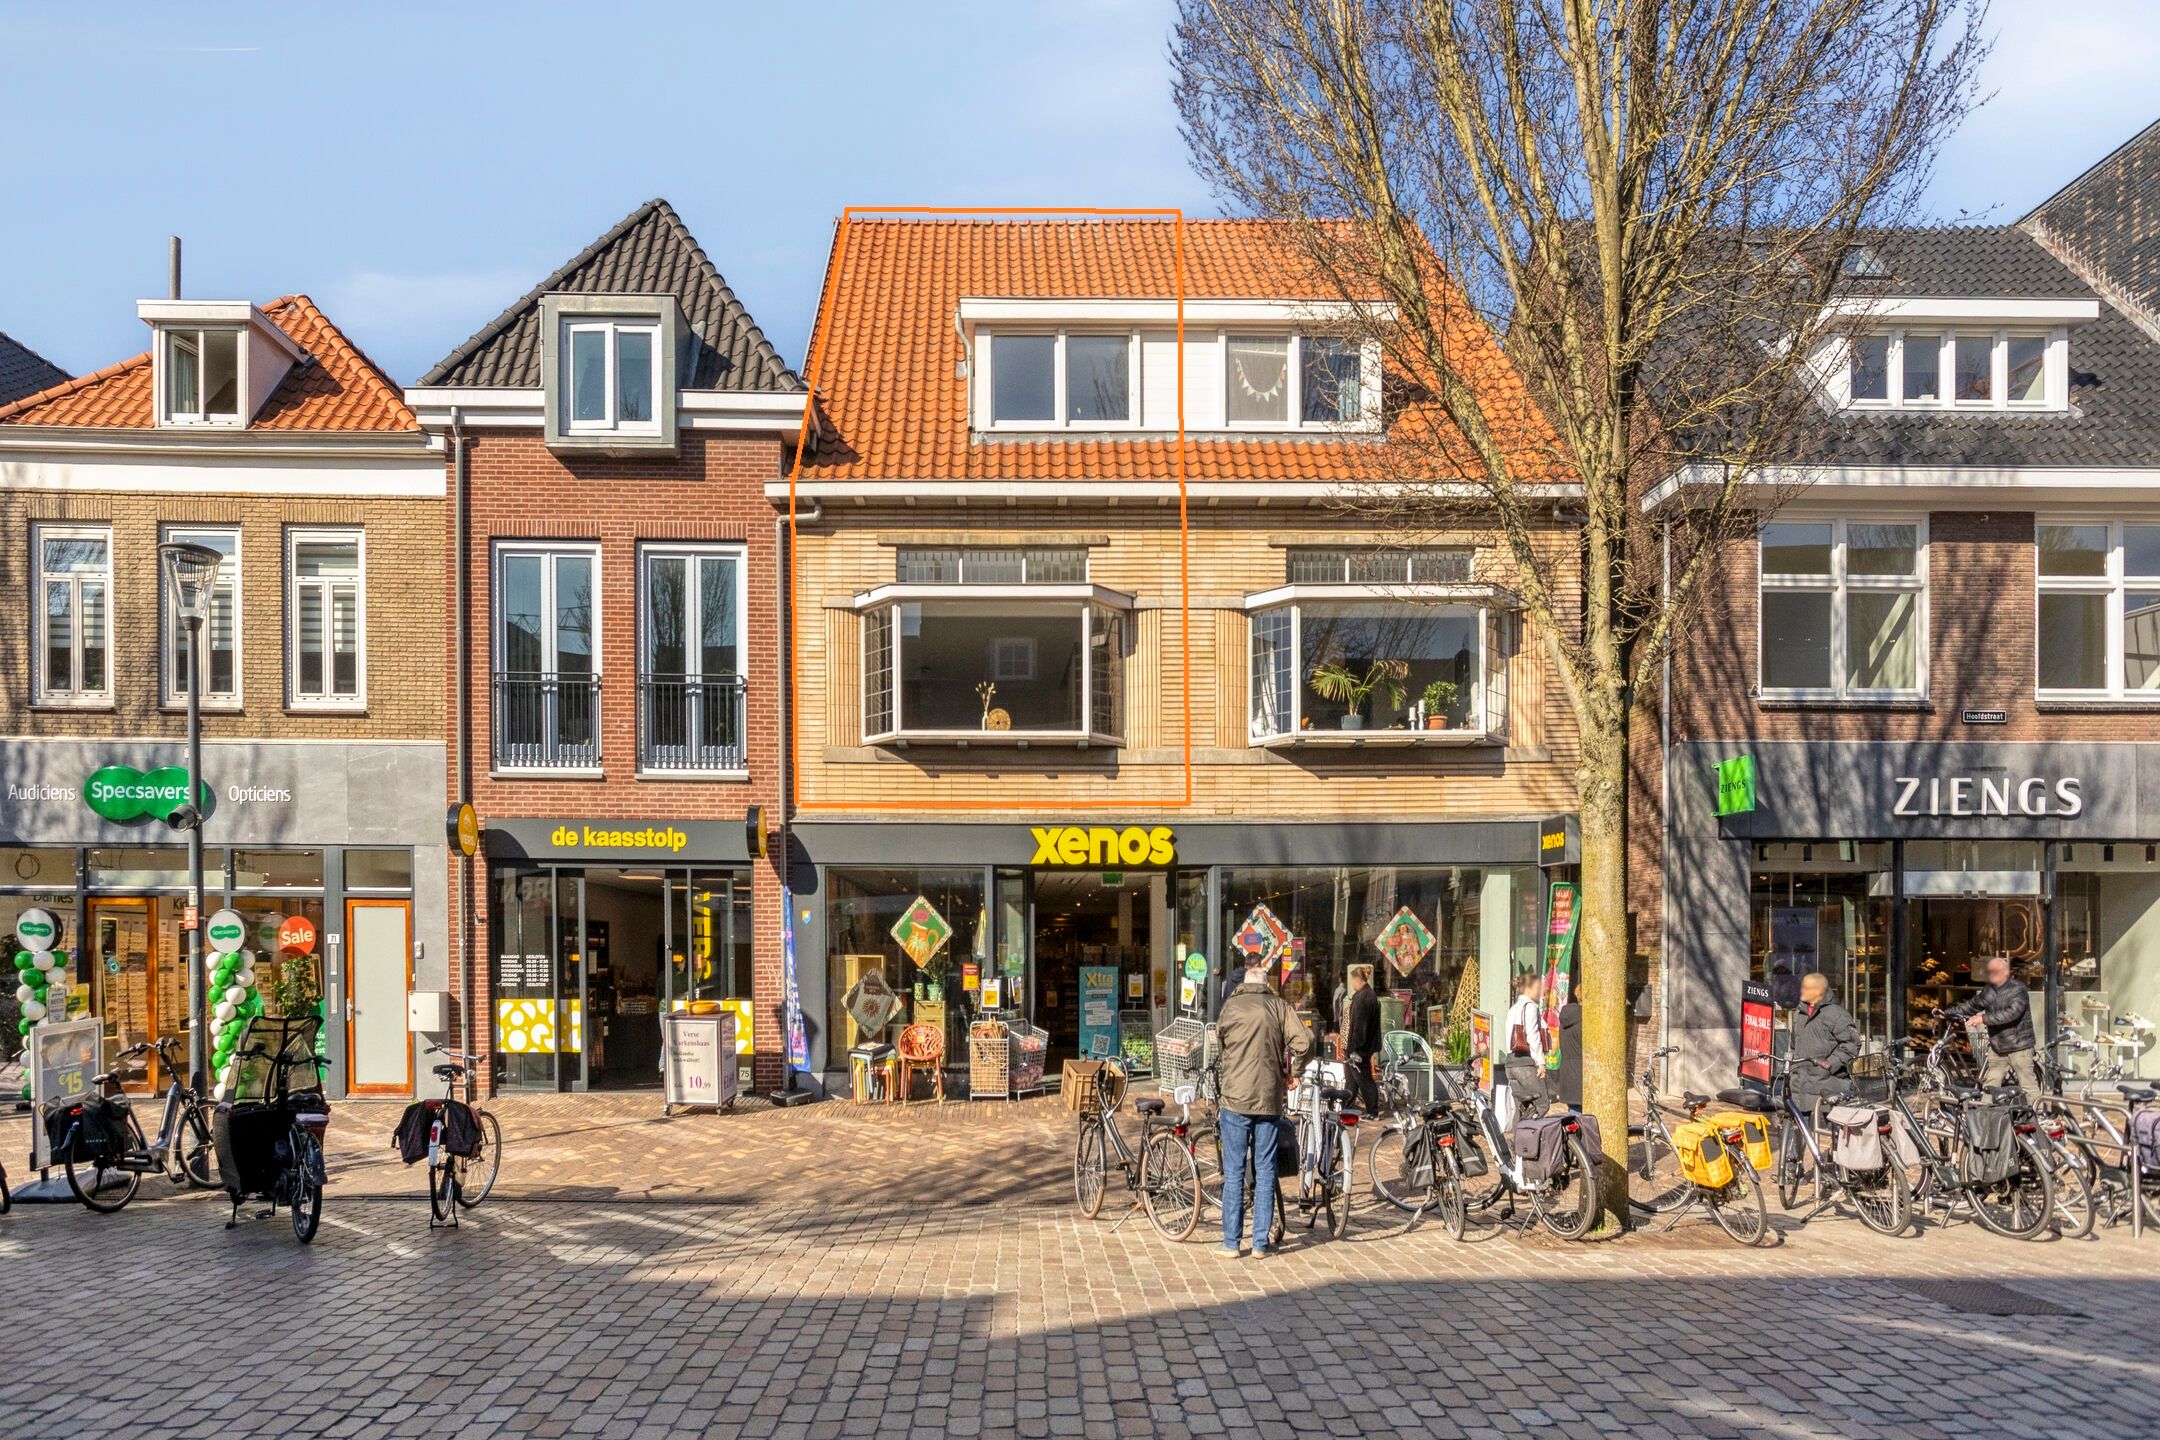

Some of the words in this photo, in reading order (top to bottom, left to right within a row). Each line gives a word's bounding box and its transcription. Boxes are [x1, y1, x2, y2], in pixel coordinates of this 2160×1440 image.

[1966, 712, 2003, 721] Hoofdstraat
[8, 784, 76, 800] Audiciens
[91, 781, 190, 801] Specsavers
[1721, 780, 1746, 793] ZIENGS
[228, 785, 292, 805] Opticiens
[1893, 777, 2082, 816] ZIENGS
[551, 825, 579, 847] de
[583, 825, 687, 853] kaasstolp
[1030, 826, 1175, 865] xenos
[1542, 831, 1565, 850] xenos
[173, 897, 189, 910] Kid
[21, 924, 50, 934] Specsavers
[212, 928, 240, 937] Specsavers
[281, 928, 313, 946] Sale
[330, 935, 337, 943] 71
[1747, 986, 1769, 998] ZIENGS
[1745, 1014, 1758, 1027] FINAL
[1758, 1017, 1770, 1029] SALE
[1750, 1028, 1769, 1050] 70%
[740, 1069, 750, 1078] 75
[58, 1071, 84, 1094] €15
